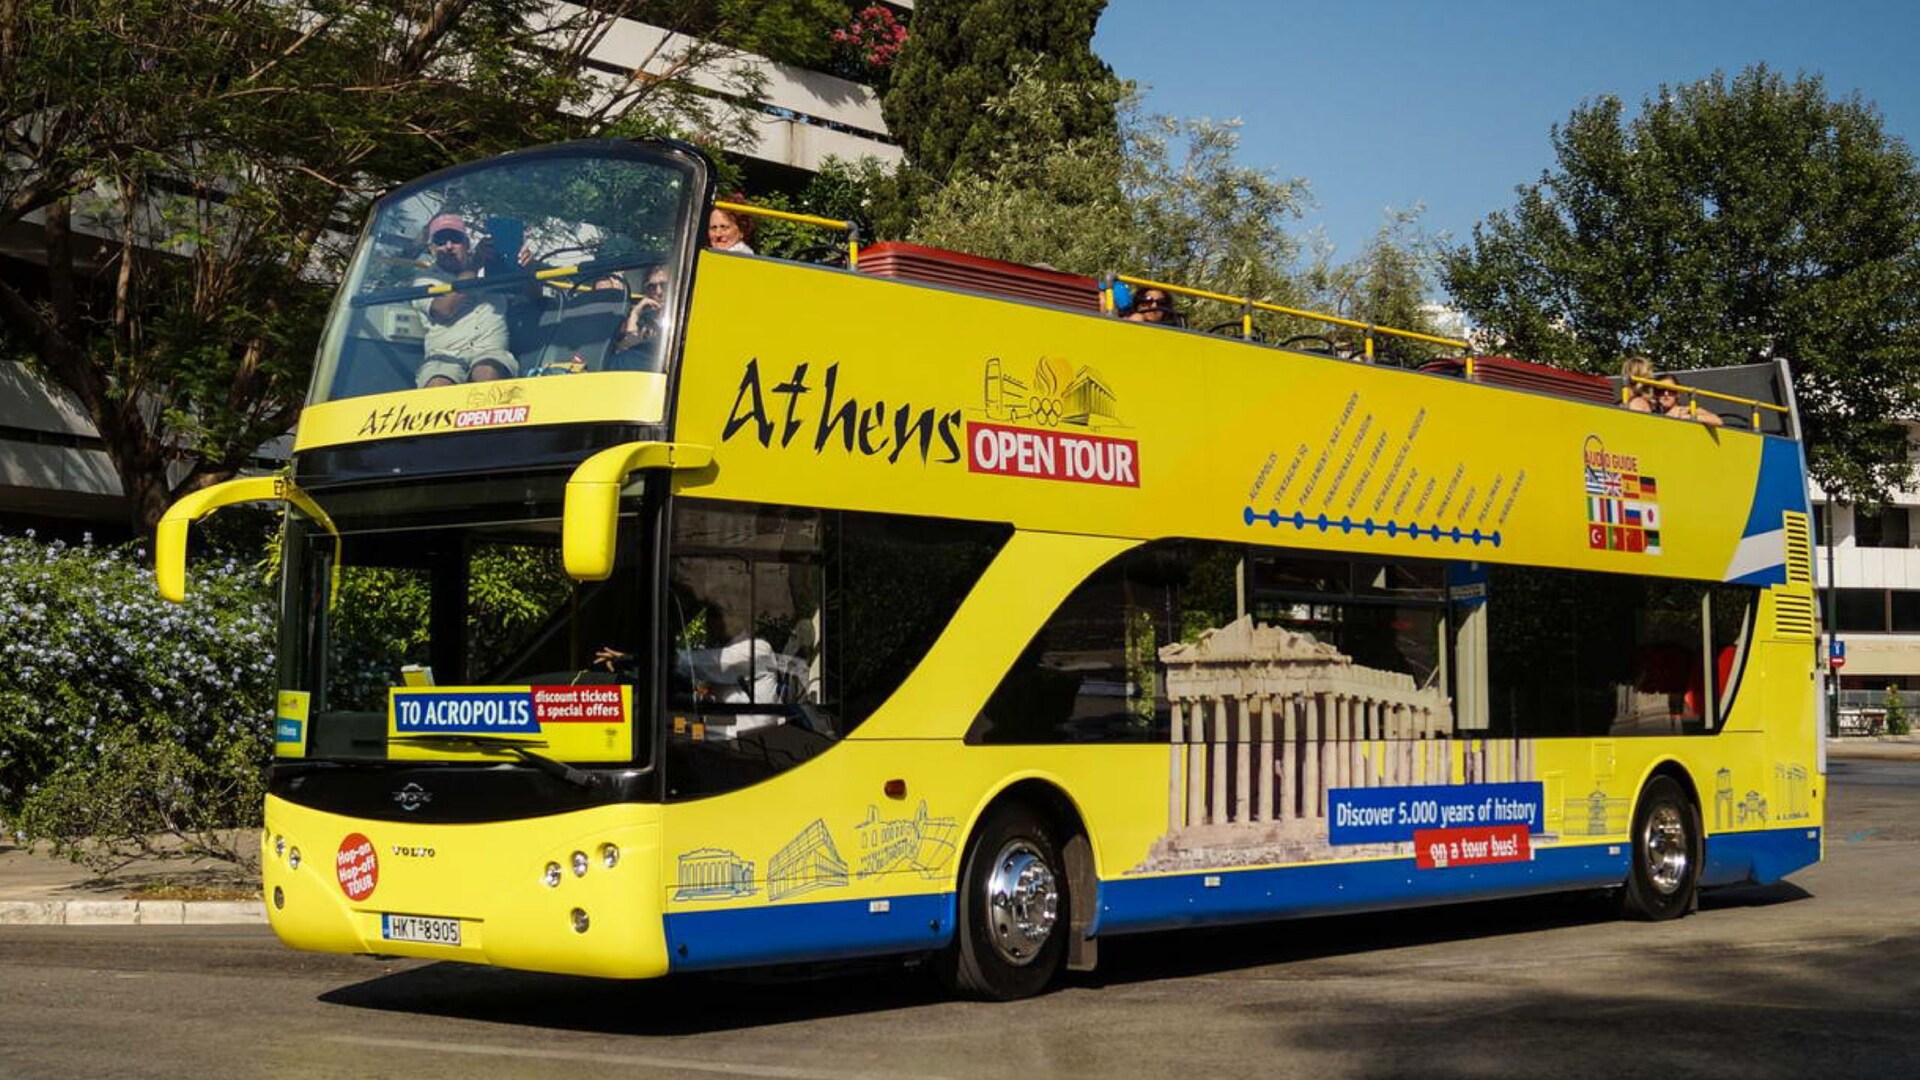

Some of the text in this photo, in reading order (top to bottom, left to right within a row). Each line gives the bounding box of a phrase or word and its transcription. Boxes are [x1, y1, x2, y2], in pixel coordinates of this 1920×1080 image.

[358, 404, 455, 436] Athens
[457, 407, 526, 427] OPEN TOUR
[721, 356, 962, 465] Athens
[974, 428, 1135, 483] OPEN TOUR
[535, 689, 620, 703] discount tickets
[400, 700, 529, 725] TO ACROPOLIS
[537, 703, 620, 719] & special offers
[1336, 797, 1537, 828] Discover 5.000 years of history
[337, 842, 372, 866] Hop-on
[392, 845, 436, 858] VOLVO
[1430, 834, 1518, 861] on a tour bus!
[339, 854, 375, 882] Hop-off
[347, 874, 374, 896] TOUR
